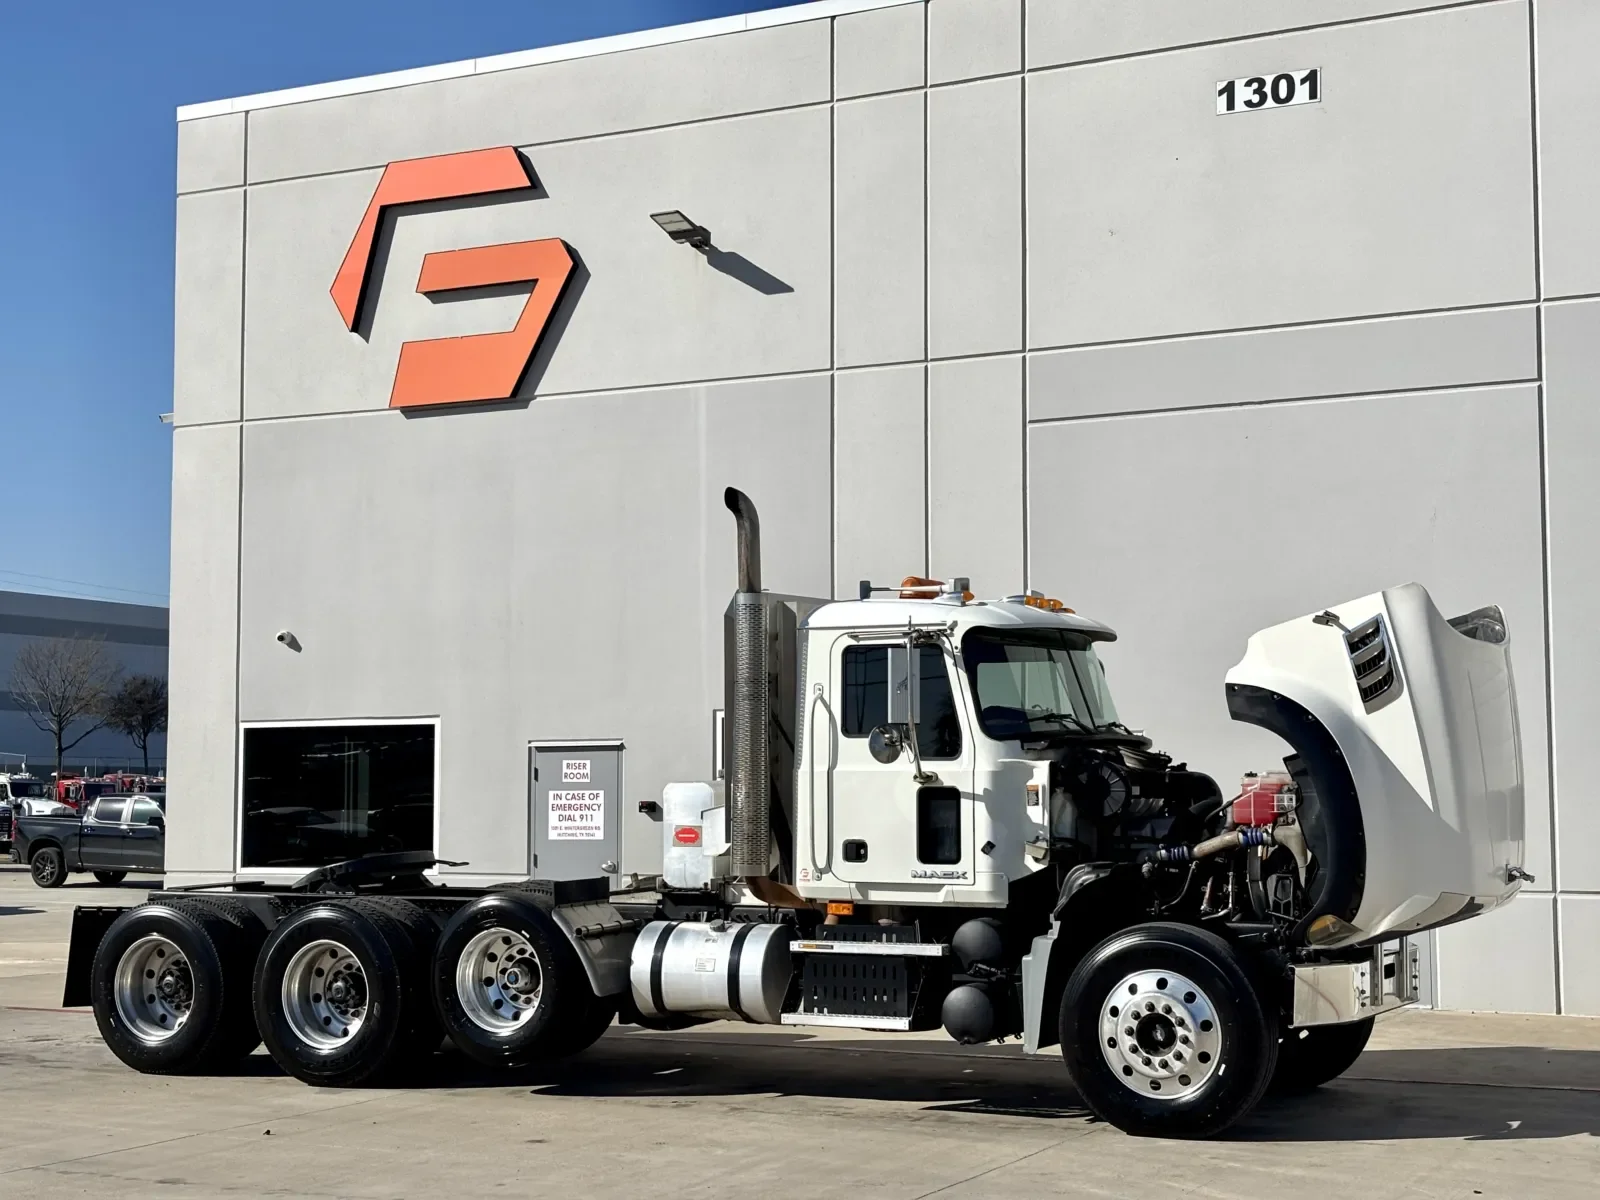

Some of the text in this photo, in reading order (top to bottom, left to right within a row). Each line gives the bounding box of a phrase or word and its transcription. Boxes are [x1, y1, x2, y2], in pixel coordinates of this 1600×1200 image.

[1217, 68, 1318, 112] 1301
[566, 762, 587, 770] RISER
[564, 772, 589, 780] ROOM
[553, 793, 600, 801] IN CASE OF
[551, 803, 601, 811] EMERGENCY
[558, 814, 593, 822] DIAL 911
[911, 869, 968, 880] MACK
